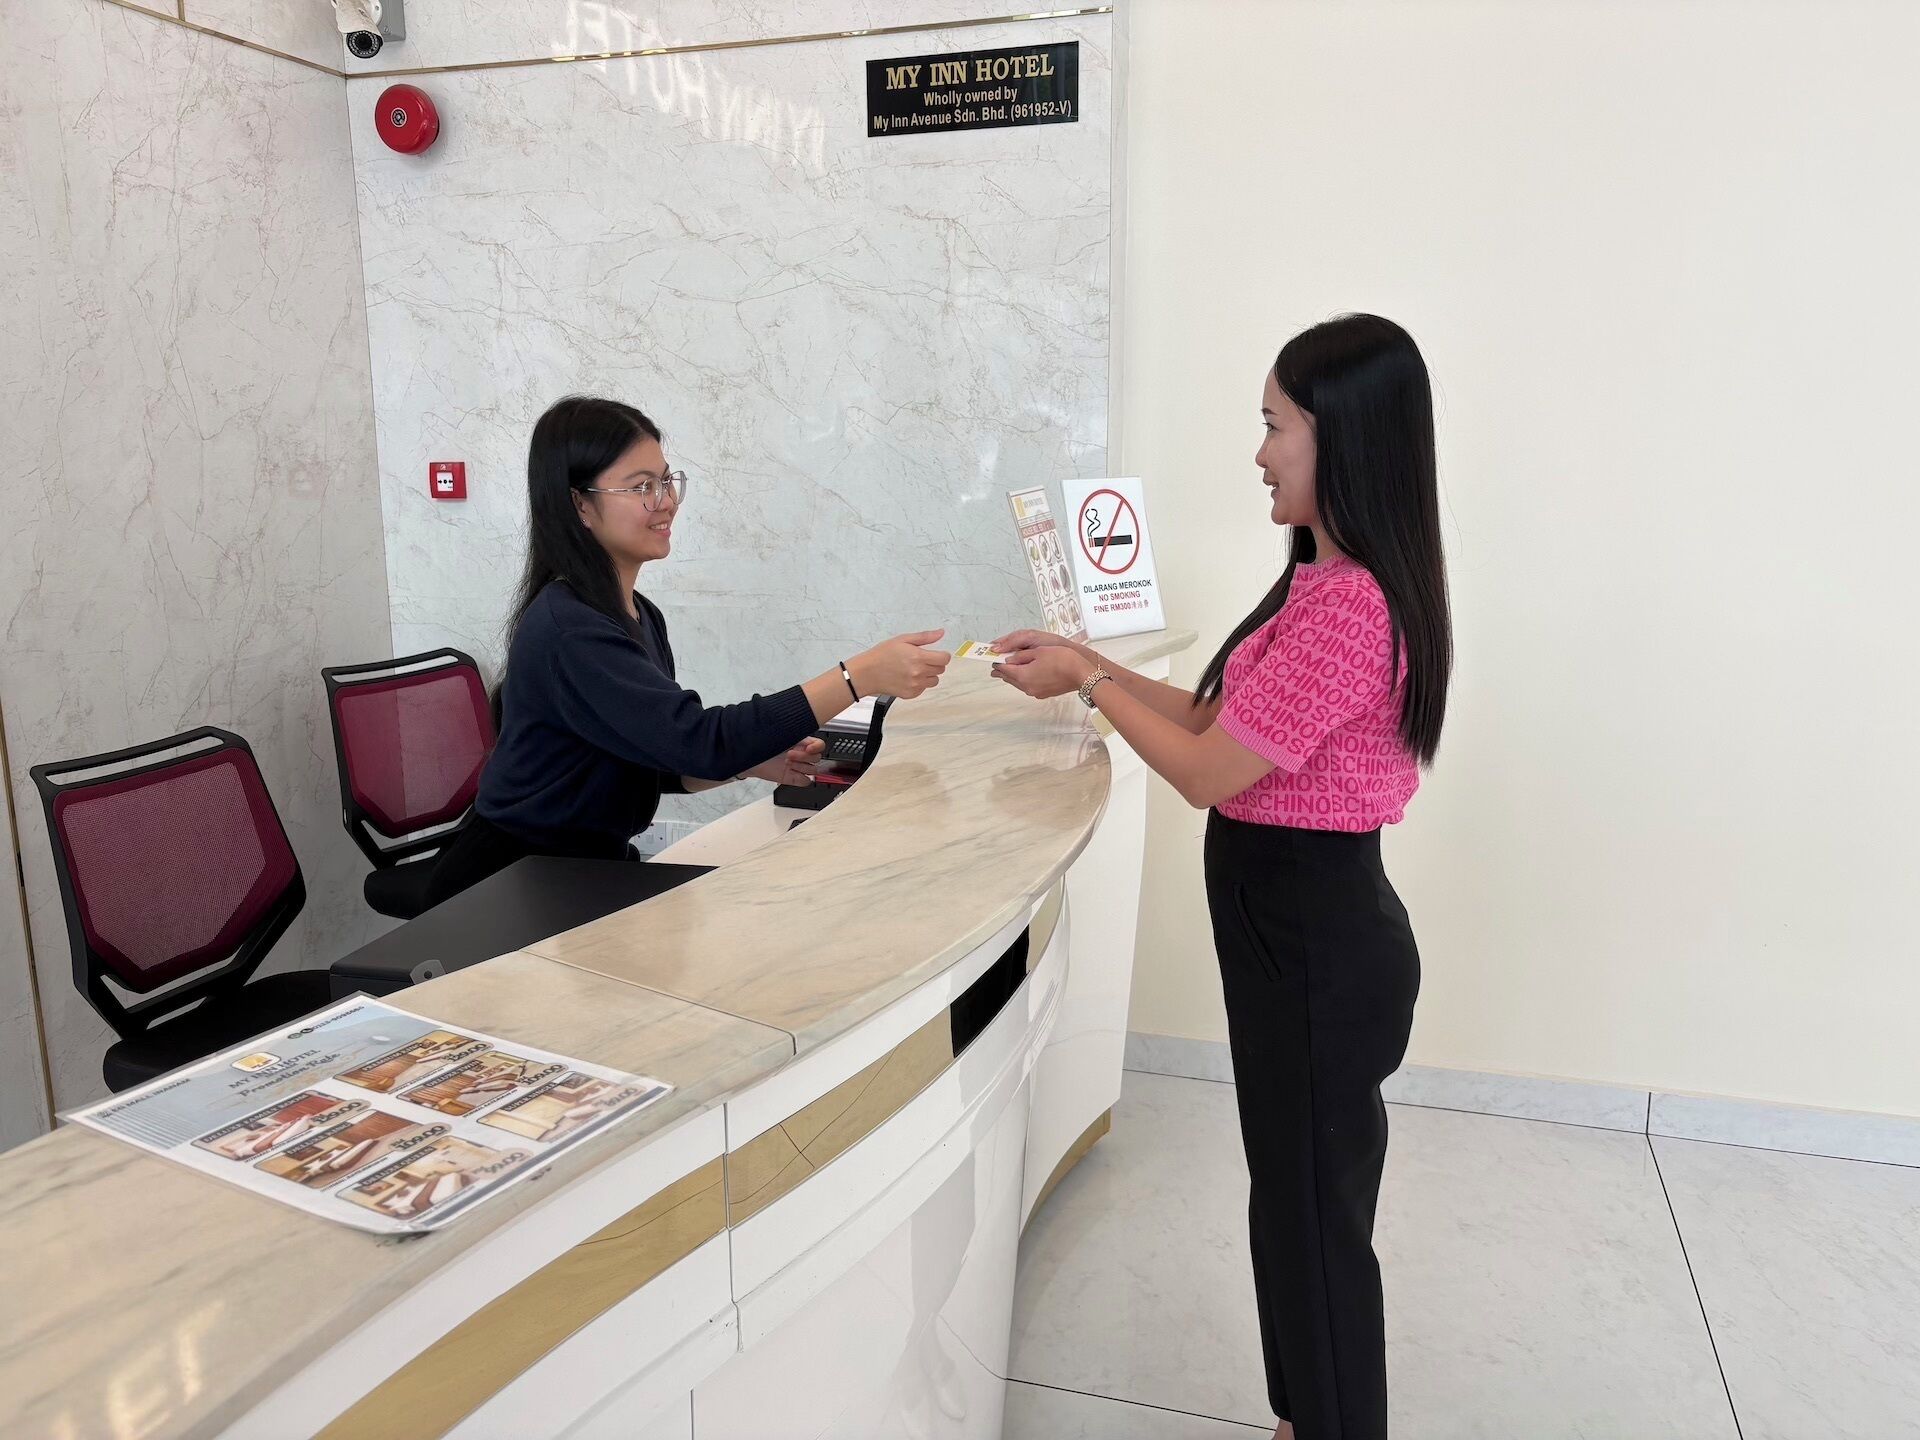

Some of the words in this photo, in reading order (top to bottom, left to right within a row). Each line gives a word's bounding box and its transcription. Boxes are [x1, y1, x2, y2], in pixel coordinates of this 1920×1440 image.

[886, 65, 922, 90] MY
[929, 60, 968, 87] INN
[975, 53, 1055, 82] HOTEL
[923, 90, 963, 107] Wholly
[964, 87, 1001, 104] owned
[1003, 87, 1018, 103] by
[873, 115, 889, 132] My
[891, 113, 908, 128] Inn
[910, 109, 952, 126] Avenue
[954, 107, 980, 123] Sdn.
[981, 105, 1008, 122] Bhd.
[1010, 99, 1072, 122] (961952-V)
[1083, 583, 1118, 594] DILARANG
[1119, 579, 1152, 589] MEROKOK
[1098, 593, 1109, 602] NO
[1110, 590, 1141, 601] SMOKING
[1094, 604, 1109, 613] FINE
[228, 1078, 251, 1089] MY
[251, 1067, 276, 1079] INN
[277, 1049, 321, 1068] HOTEL
[239, 1065, 310, 1097] Promotion
[306, 1053, 341, 1067] Rate
[504, 1096, 530, 1112] SUPER
[203, 1121, 242, 1143] DELUXE
[243, 1106, 278, 1126] FAMILY
[284, 1133, 324, 1155] DELUXE
[398, 1125, 446, 1151] 109.00
